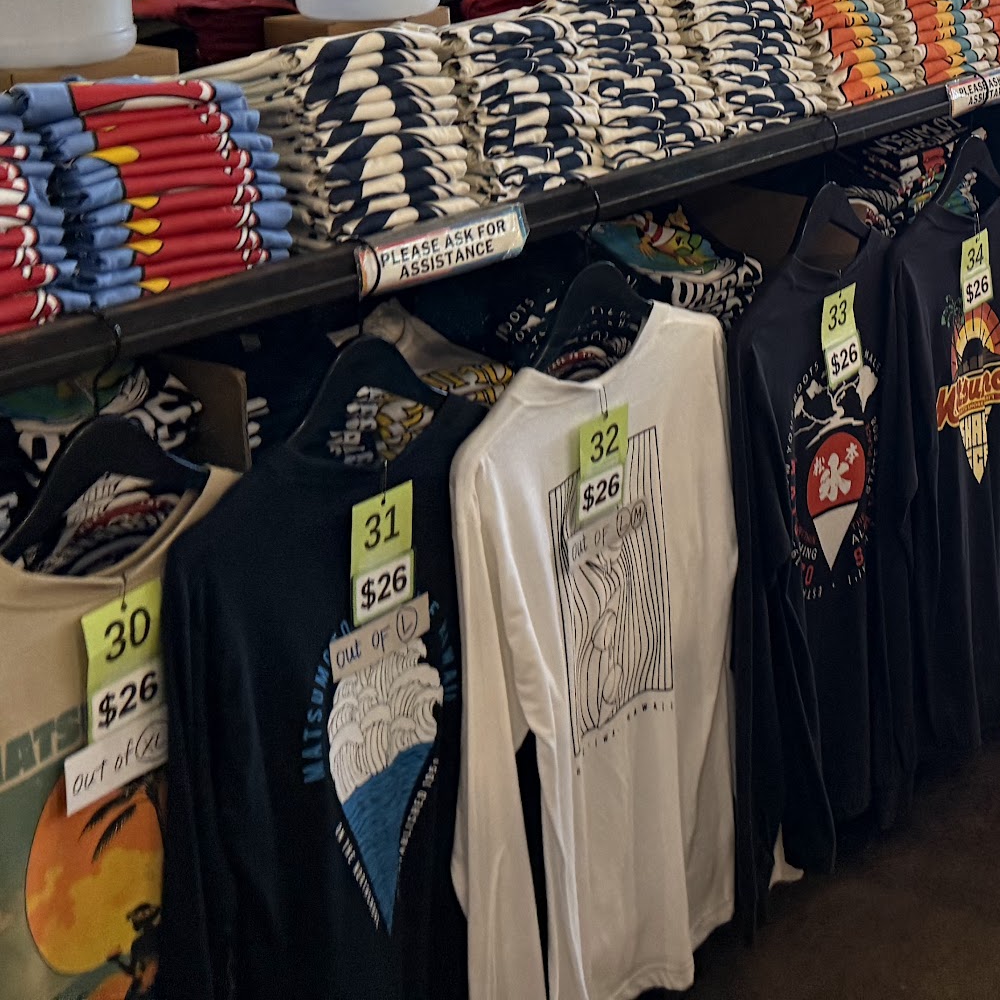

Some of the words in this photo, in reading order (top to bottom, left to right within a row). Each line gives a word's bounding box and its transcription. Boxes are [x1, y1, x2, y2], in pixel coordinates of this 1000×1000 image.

[959, 82, 987, 96] PLEASE
[380, 238, 440, 267] PLEASE
[444, 226, 473, 248] ASK
[477, 219, 506, 239] FOR
[400, 239, 494, 280] ASSISTANCE
[967, 244, 984, 268] 34
[966, 276, 989, 304] $26
[828, 300, 847, 331] 33
[831, 344, 858, 376] $26
[590, 423, 620, 464] 32
[582, 474, 620, 512] $26
[364, 504, 401, 551] 31
[572, 540, 588, 562] out
[594, 528, 608, 549] OF
[360, 565, 408, 611] $26
[105, 607, 151, 663] 30
[336, 641, 363, 668] out
[371, 625, 390, 650] OF
[98, 670, 159, 729] $26
[72, 759, 107, 798] out
[113, 739, 138, 773] of
